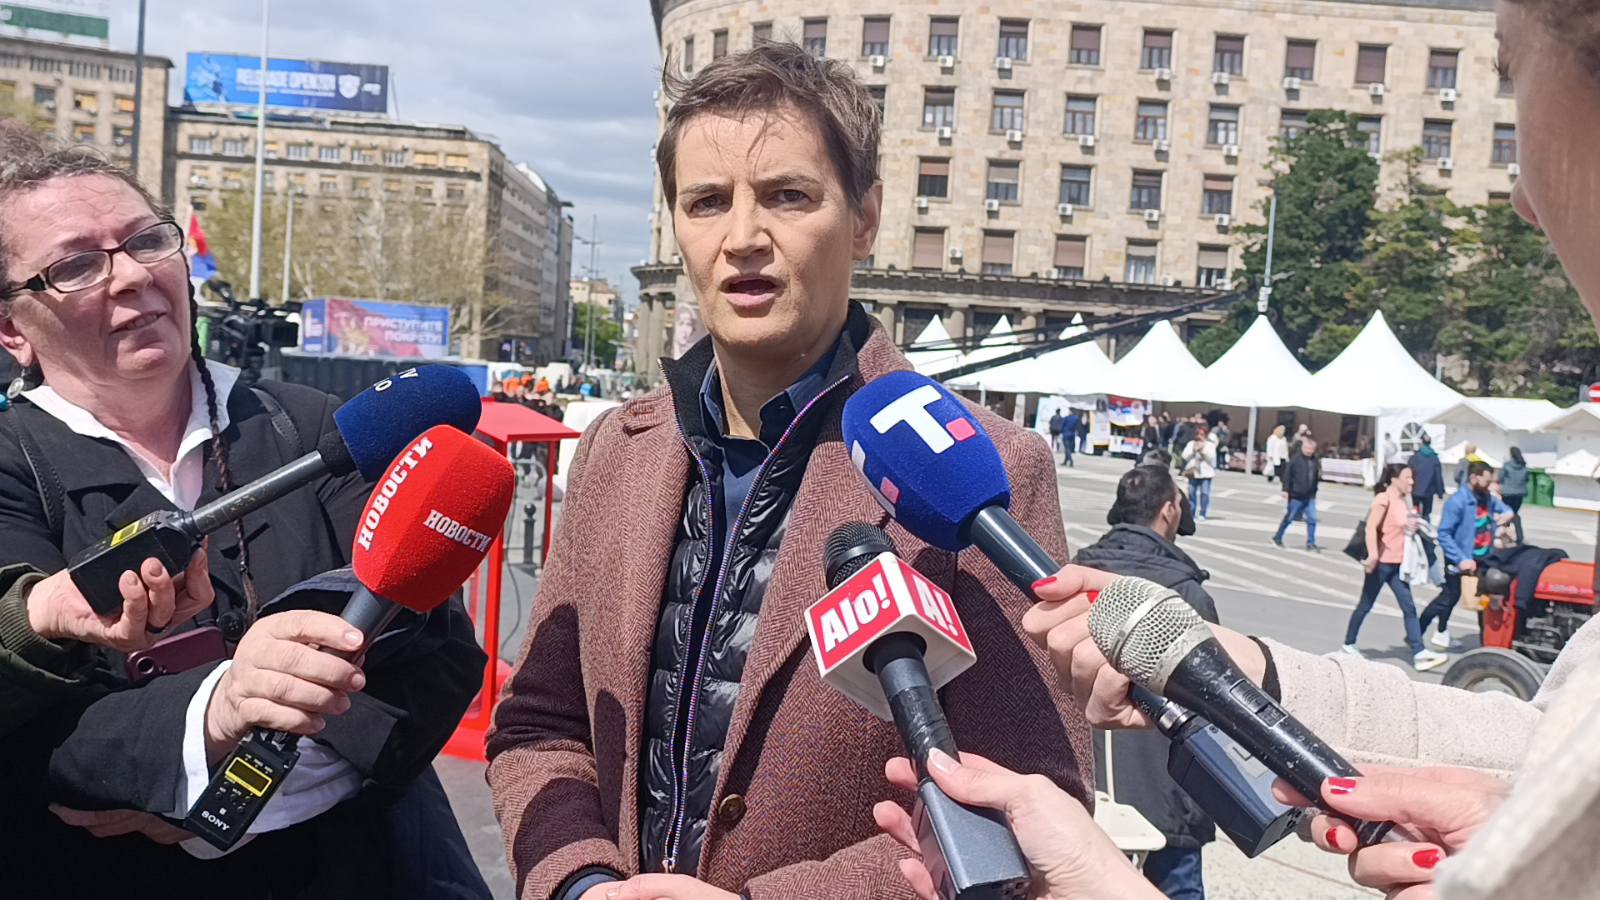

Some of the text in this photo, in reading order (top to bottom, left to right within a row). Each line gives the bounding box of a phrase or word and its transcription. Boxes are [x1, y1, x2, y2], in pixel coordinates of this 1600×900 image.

[358, 436, 433, 550] НОВОСТИ
[423, 509, 491, 552] НОВОСТИ
[201, 810, 230, 831] SONY
